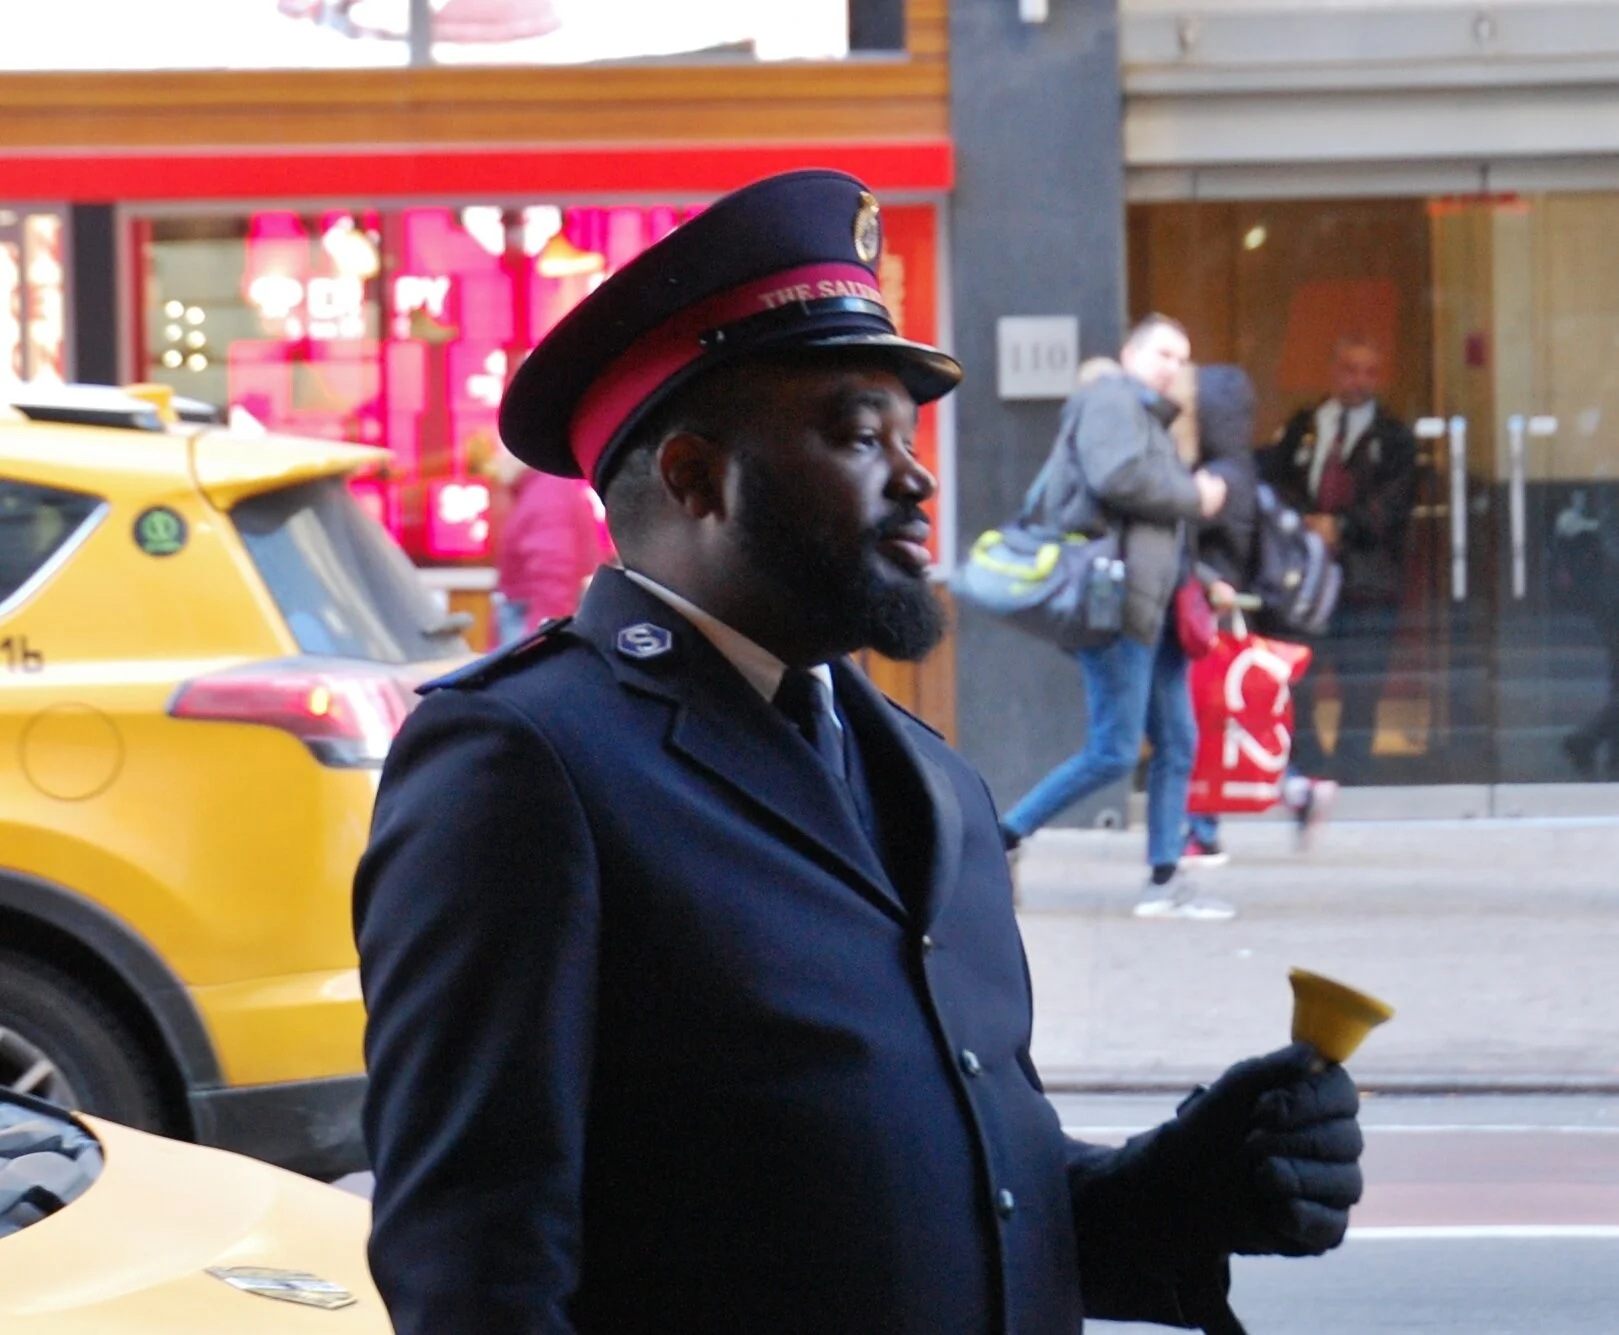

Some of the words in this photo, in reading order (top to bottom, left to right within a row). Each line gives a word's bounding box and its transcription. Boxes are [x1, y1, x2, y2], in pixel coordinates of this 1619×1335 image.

[758, 283, 816, 309] THE
[816, 279, 883, 304] SAL
[1010, 341, 1069, 374] 110
